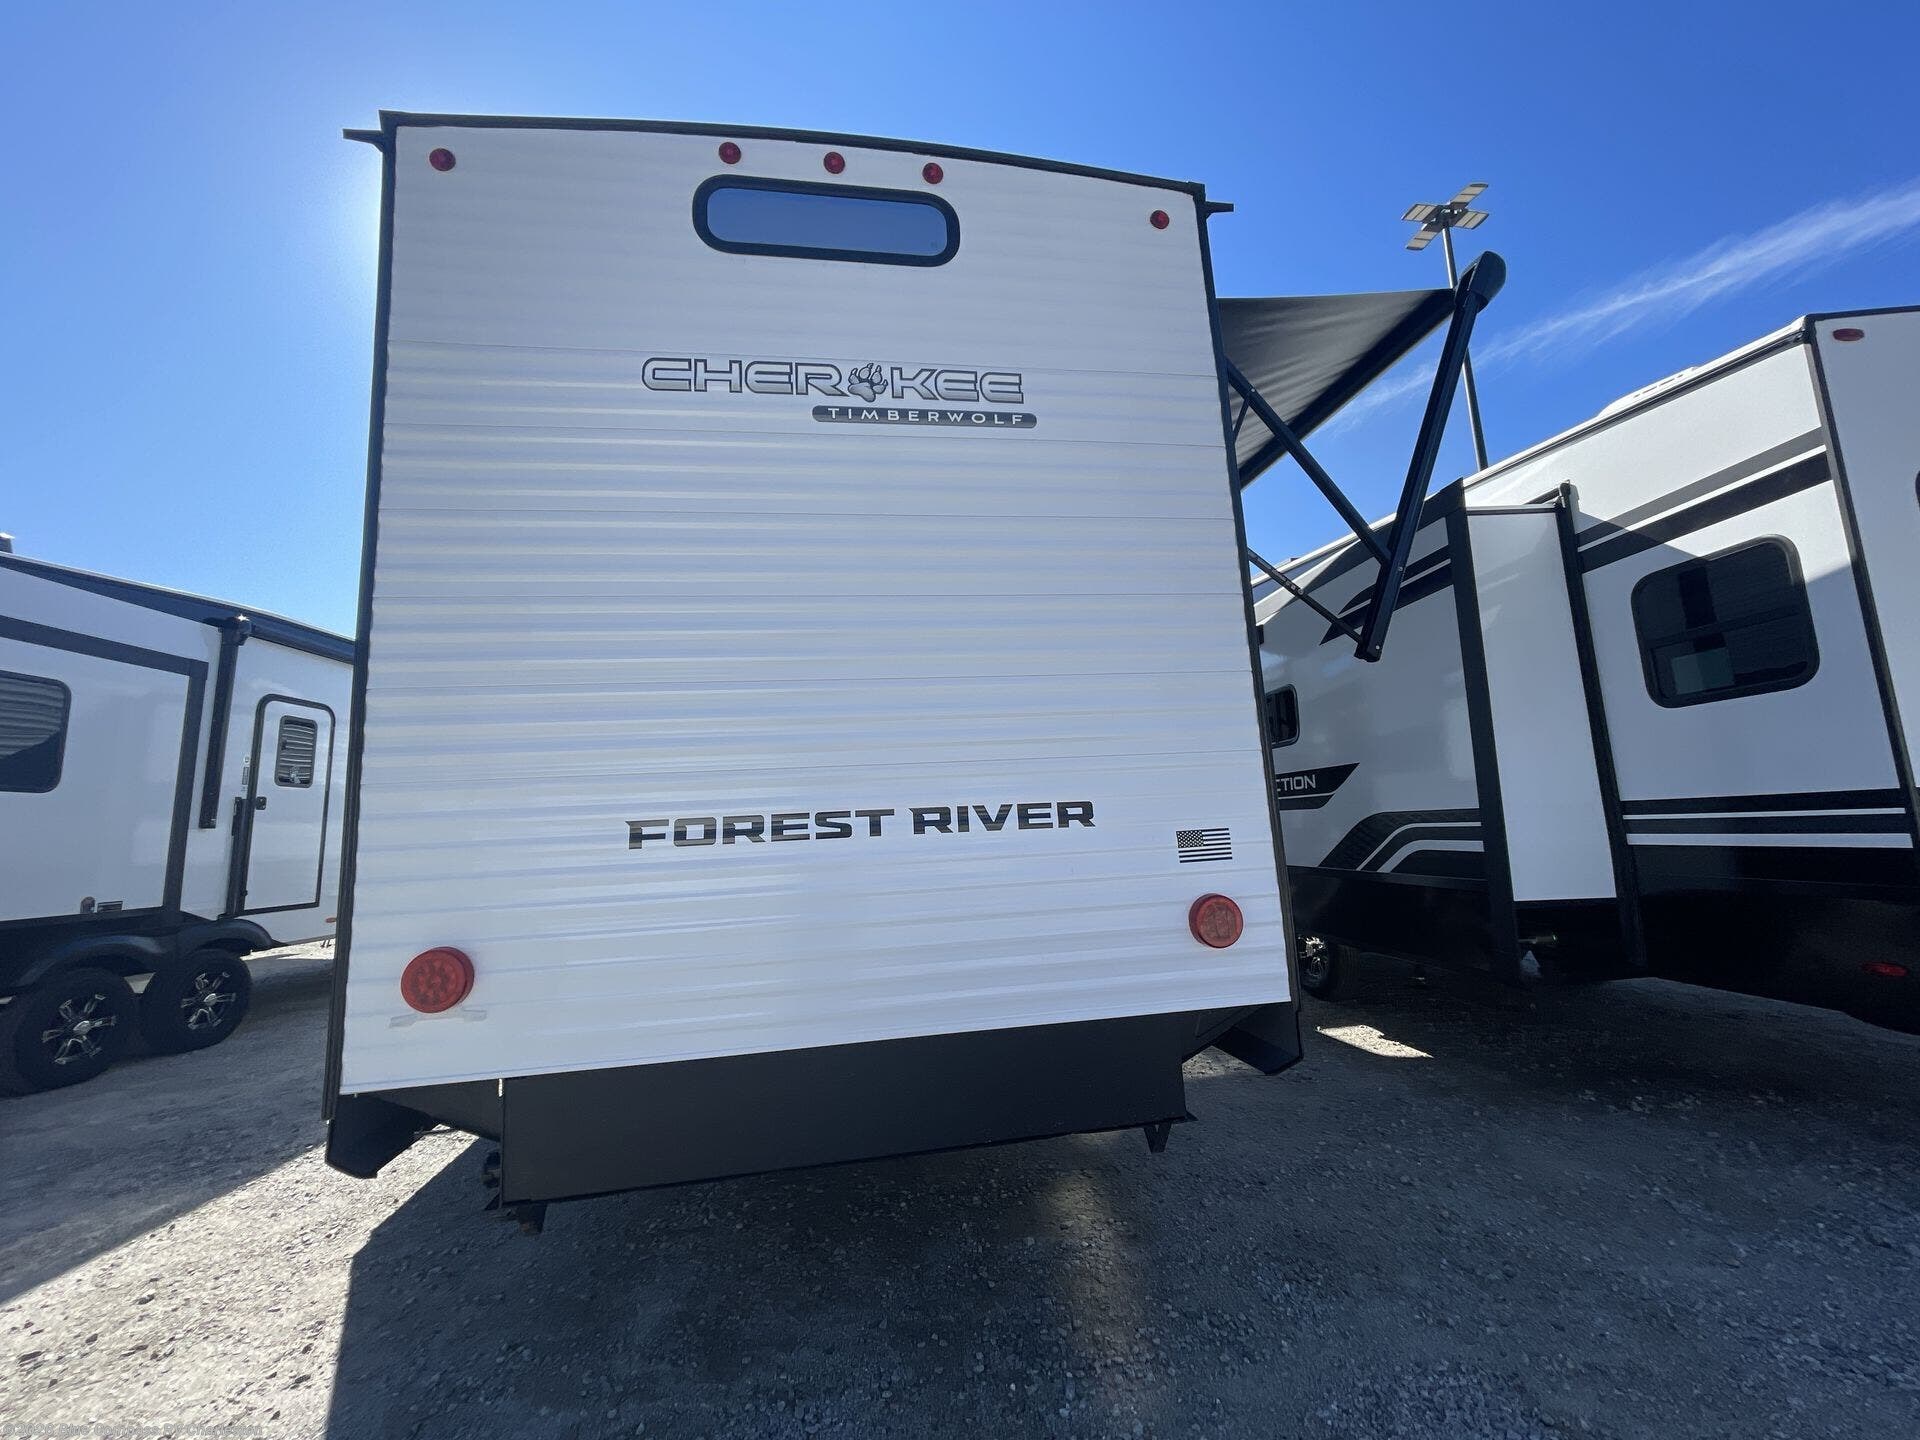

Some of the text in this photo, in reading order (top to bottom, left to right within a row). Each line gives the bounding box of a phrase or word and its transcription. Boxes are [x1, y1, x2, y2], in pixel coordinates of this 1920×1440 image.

[828, 407, 1024, 425] TIMBERWOLF
[625, 801, 1096, 850] FOREST RIVER
